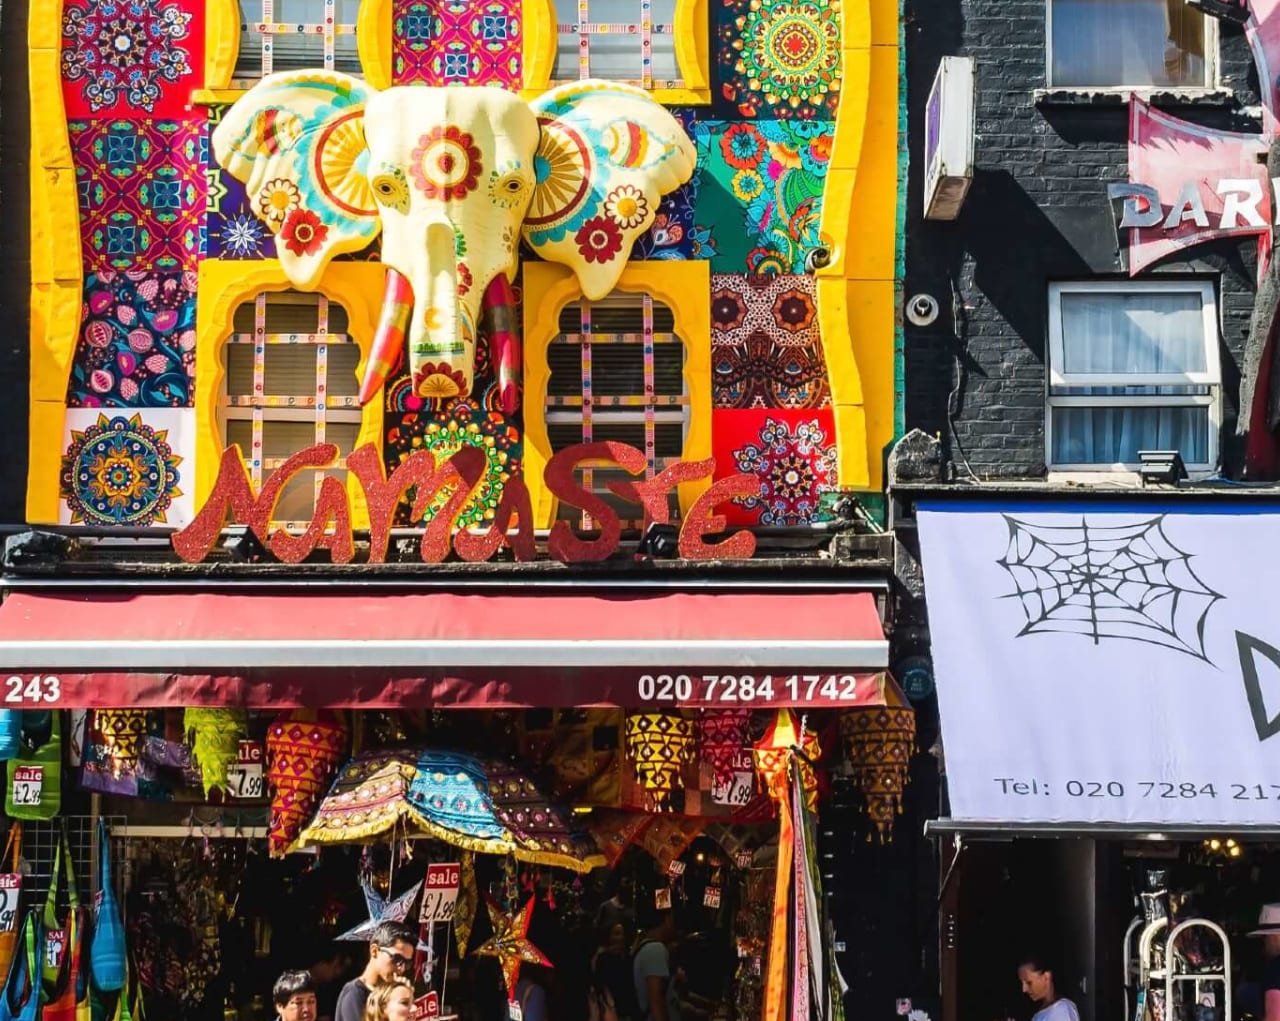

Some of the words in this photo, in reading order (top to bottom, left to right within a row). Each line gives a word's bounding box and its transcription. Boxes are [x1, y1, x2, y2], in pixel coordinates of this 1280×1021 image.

[5, 676, 61, 703] 243
[638, 674, 692, 700] 020
[702, 674, 775, 701] 7284
[784, 674, 857, 701] 1742
[14, 770, 42, 781] sale
[993, 777, 1051, 797] Tel:
[1065, 779, 1125, 798] 020
[1137, 782, 1218, 799] 7284
[429, 868, 459, 885] sale
